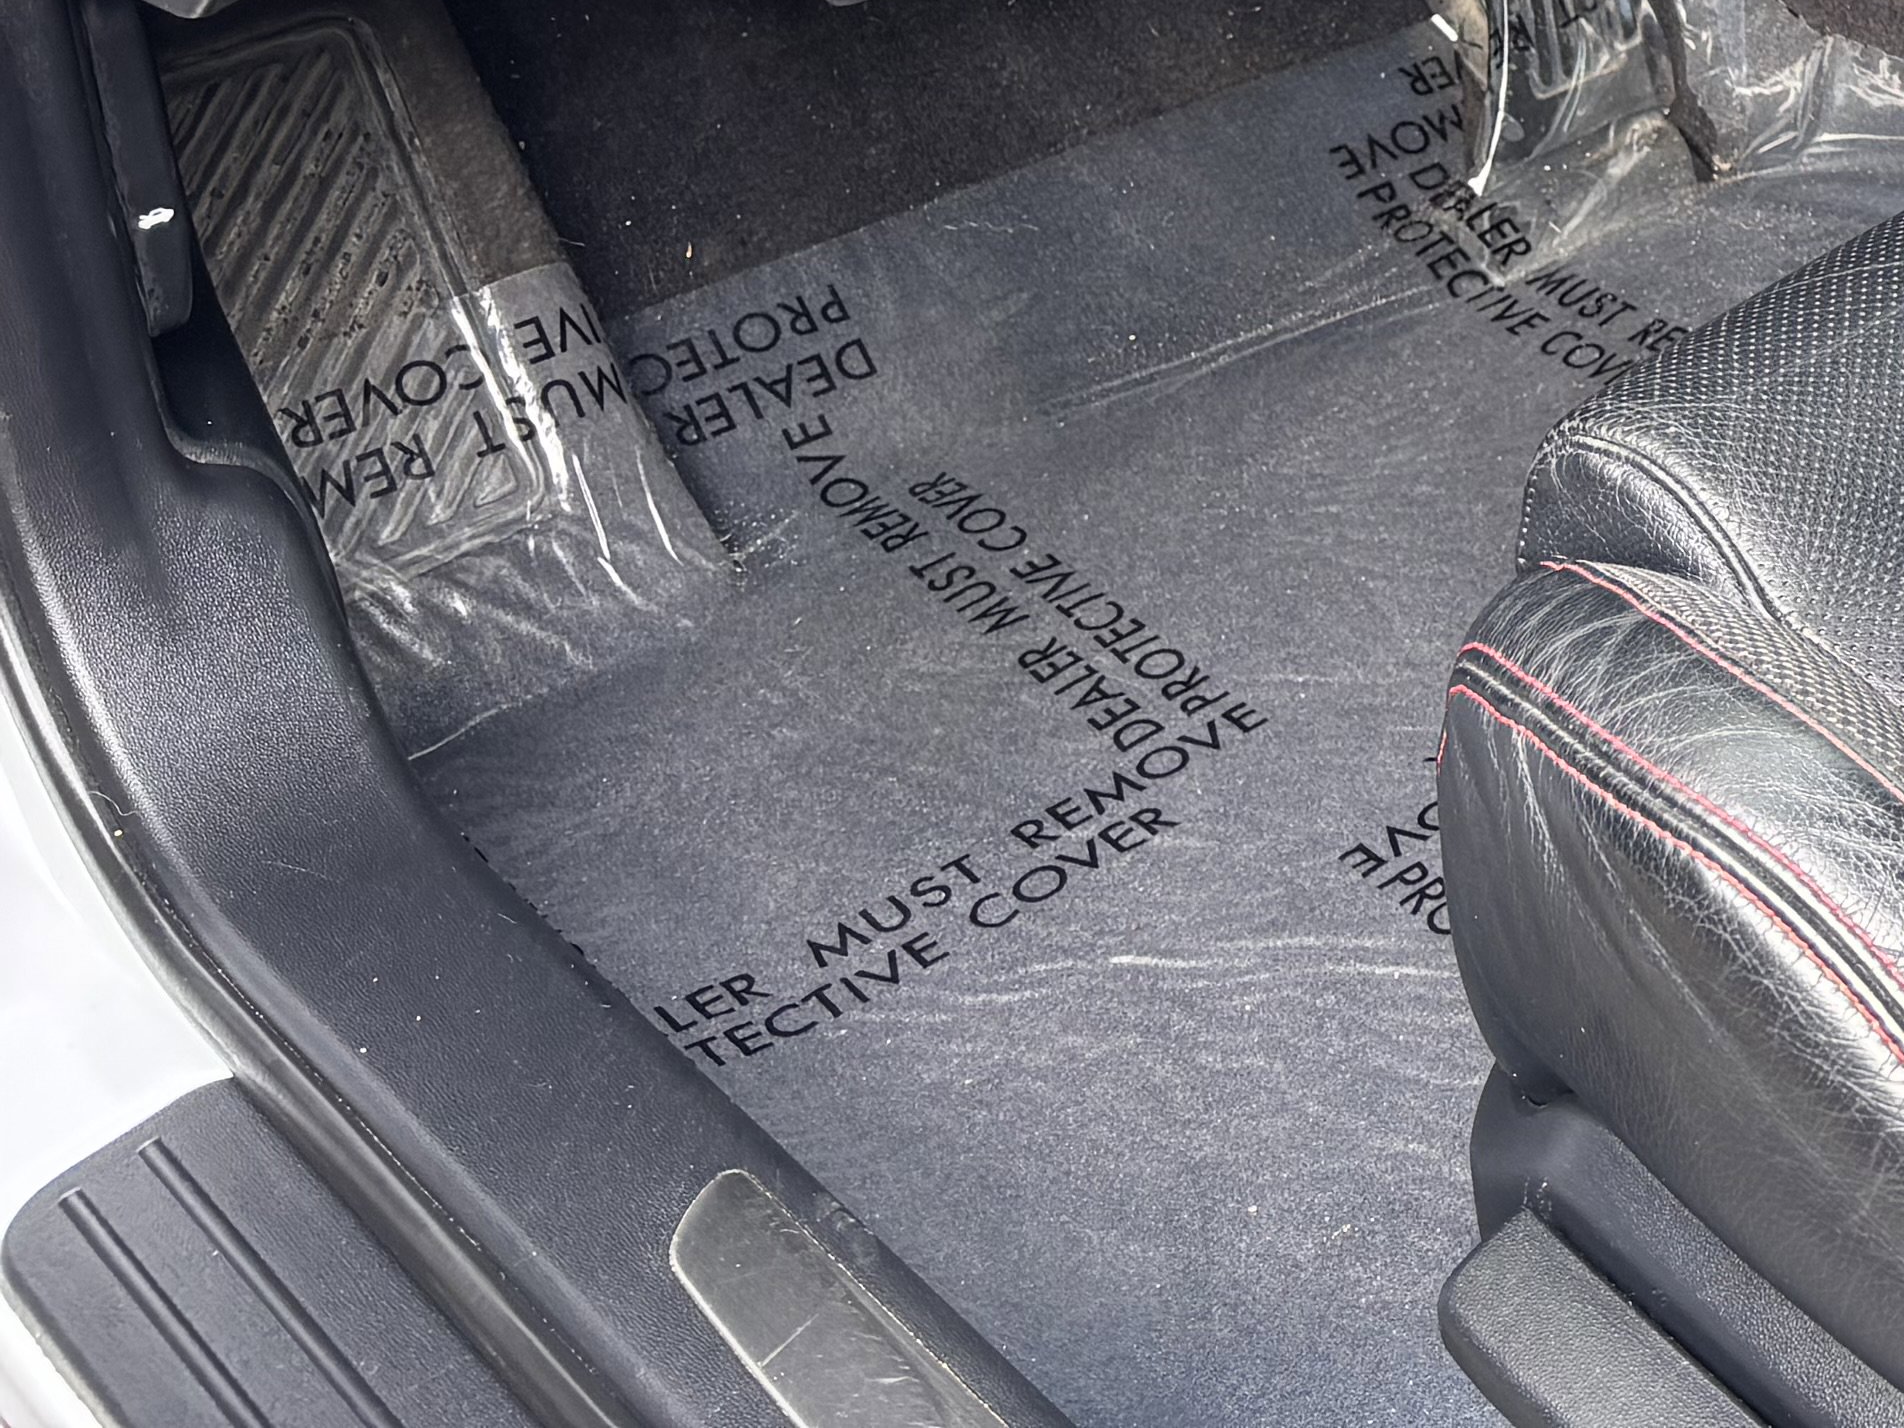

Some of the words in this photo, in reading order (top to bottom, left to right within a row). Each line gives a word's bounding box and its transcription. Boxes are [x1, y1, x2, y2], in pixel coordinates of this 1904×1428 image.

[1525, 264, 1638, 326] MUST
[277, 344, 484, 448] COVER
[661, 337, 878, 447] DEALER
[1540, 330, 1634, 386] COV
[300, 432, 436, 520] REM
[781, 413, 929, 554] REMOVE
[908, 471, 1027, 552] COVER
[908, 551, 1031, 635] MUST
[1009, 553, 1230, 717] PROTECTIVE
[1017, 636, 1166, 753] DEALER
[653, 972, 773, 1034] LER
[806, 854, 982, 968] MUST
[1009, 700, 1269, 850] REMOVE
[684, 931, 951, 1068] TECTIVE
[968, 806, 1181, 928] COVER
